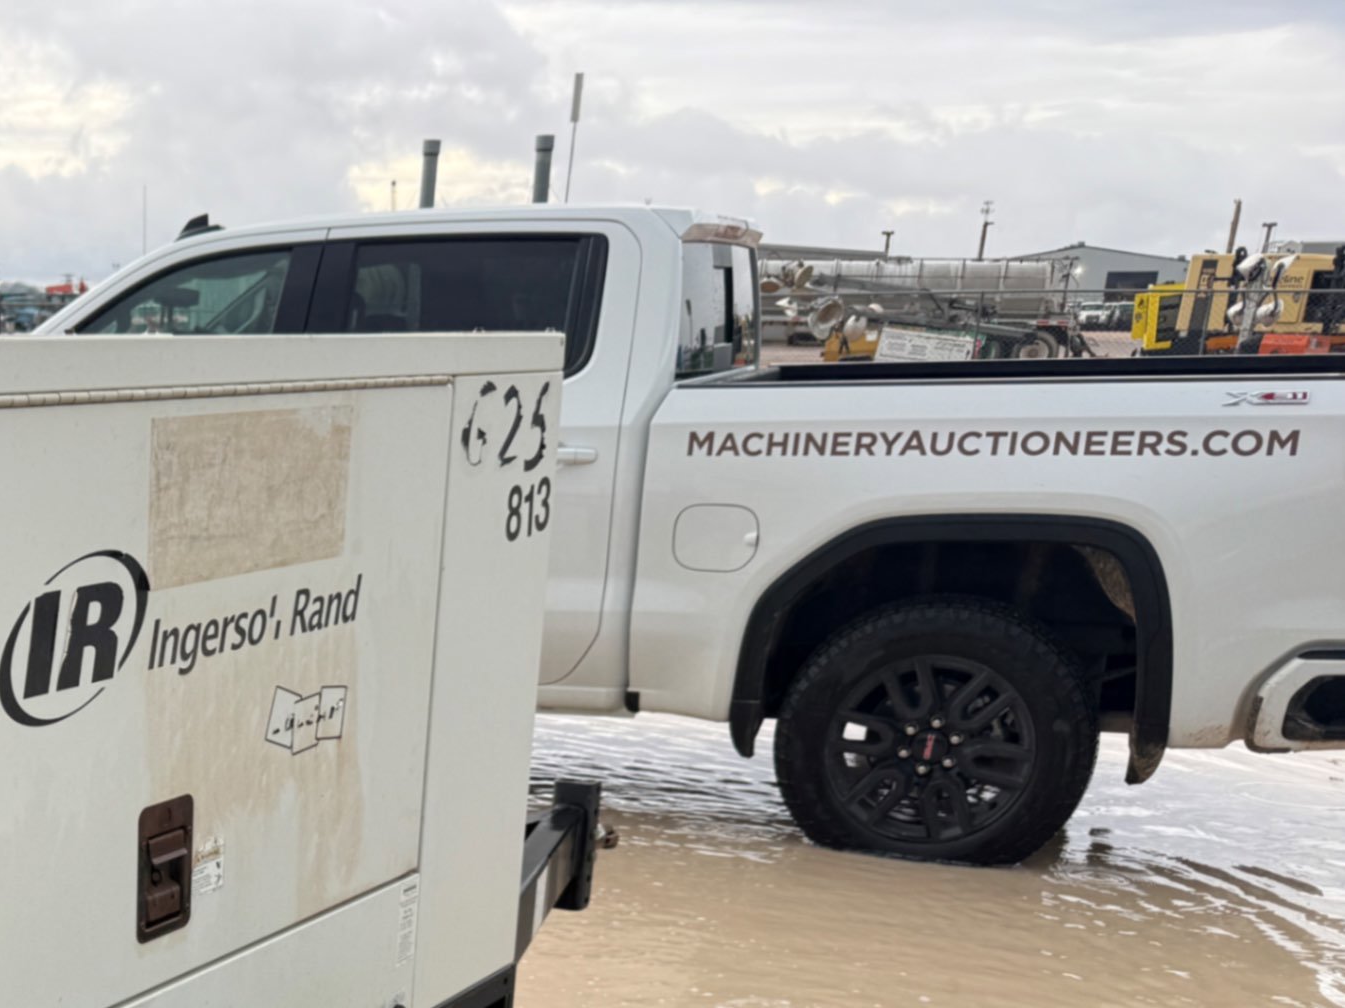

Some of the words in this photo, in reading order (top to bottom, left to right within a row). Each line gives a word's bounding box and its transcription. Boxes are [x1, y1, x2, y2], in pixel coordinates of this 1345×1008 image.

[686, 430, 1301, 457] MACHINERYAUCTIONEERS.COM
[506, 476, 551, 542] 813
[289, 573, 363, 637] Rand
[23, 581, 125, 700] IR
